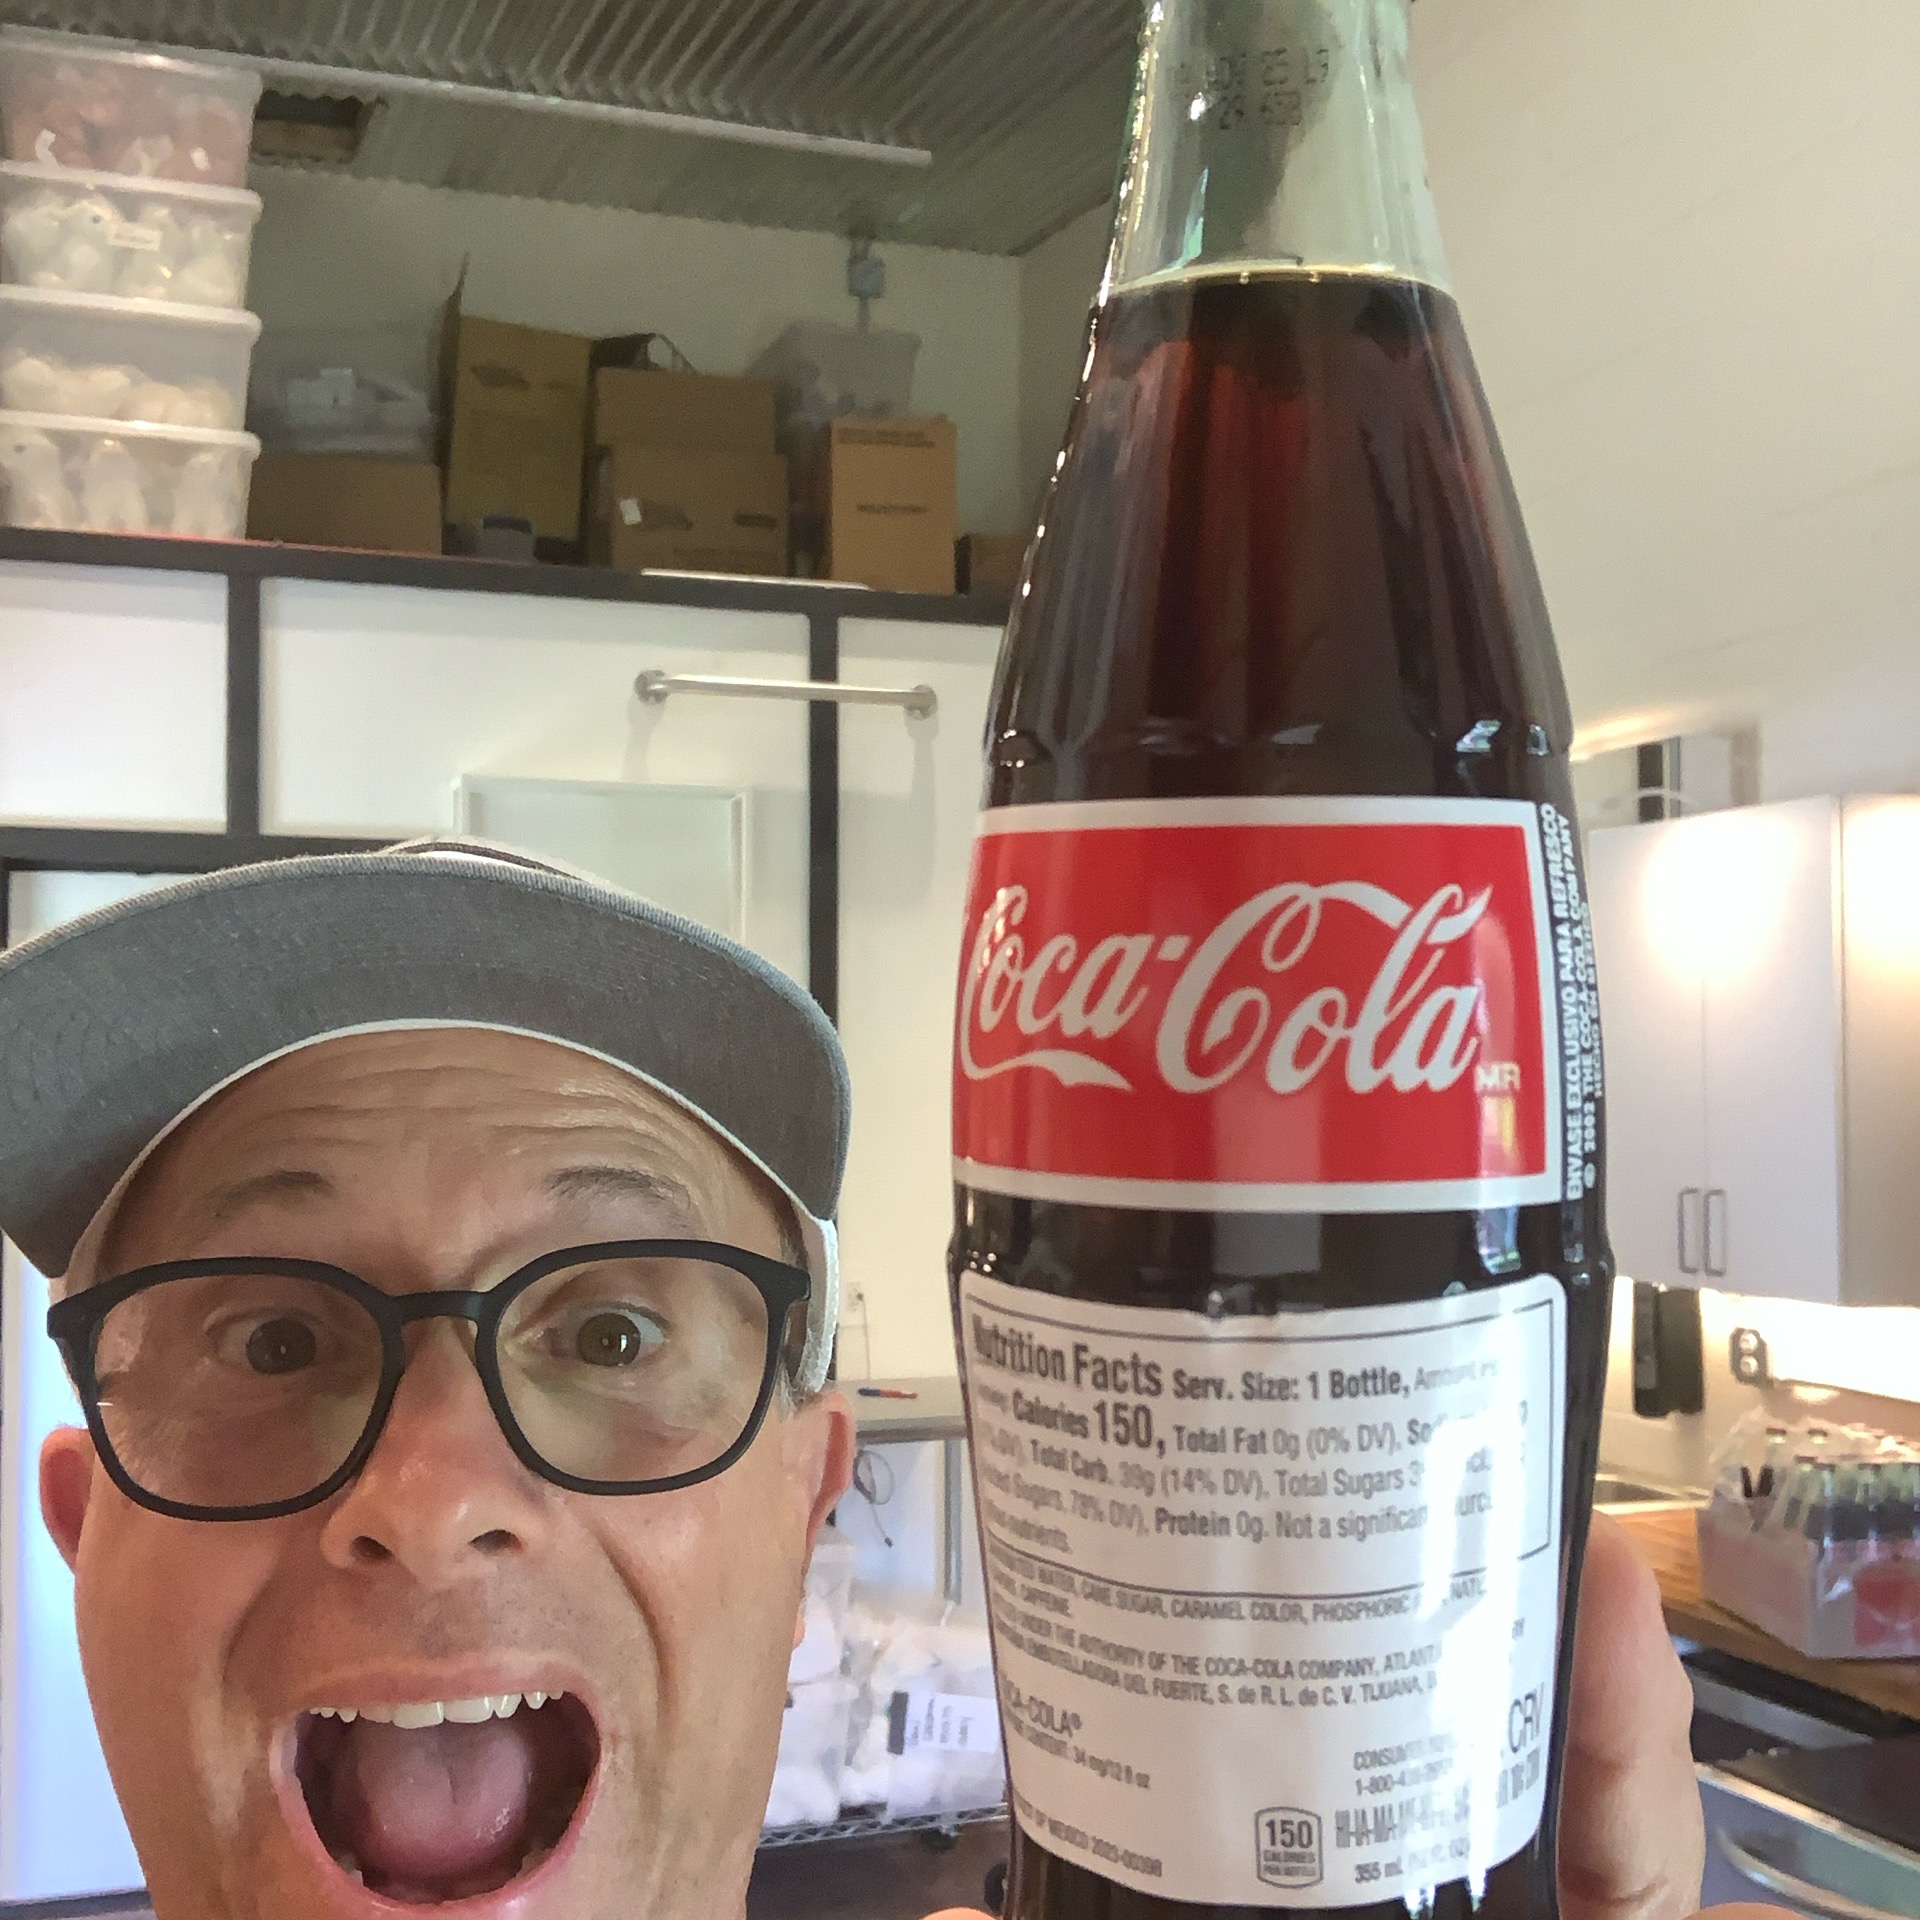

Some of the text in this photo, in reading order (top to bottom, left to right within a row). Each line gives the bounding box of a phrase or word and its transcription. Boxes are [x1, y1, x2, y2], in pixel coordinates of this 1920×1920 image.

[959, 880, 1494, 1095] Coca-Cola
[1540, 802, 1584, 1201] ENVASE EXCLUSIVO PARA REFRESCO
[1072, 1341, 1163, 1397] Facts
[1172, 1367, 1235, 1400] Serv.
[1241, 1370, 1299, 1401] Size:
[1307, 1370, 1319, 1400] 1
[1330, 1365, 1411, 1399] Bottle,
[1093, 1399, 1167, 1460] 150,
[1173, 1423, 1228, 1454] Total
[1233, 1426, 1268, 1455] Fat
[1274, 1467, 1329, 1497] Total
[1332, 1467, 1405, 1501] Sugars
[1154, 1506, 1231, 1537] Protein
[1275, 1510, 1314, 1540] Not
[1318, 1516, 1332, 1540] a
[1204, 1656, 1295, 1679] COCA-COLA
[1265, 1818, 1313, 1849] 150
